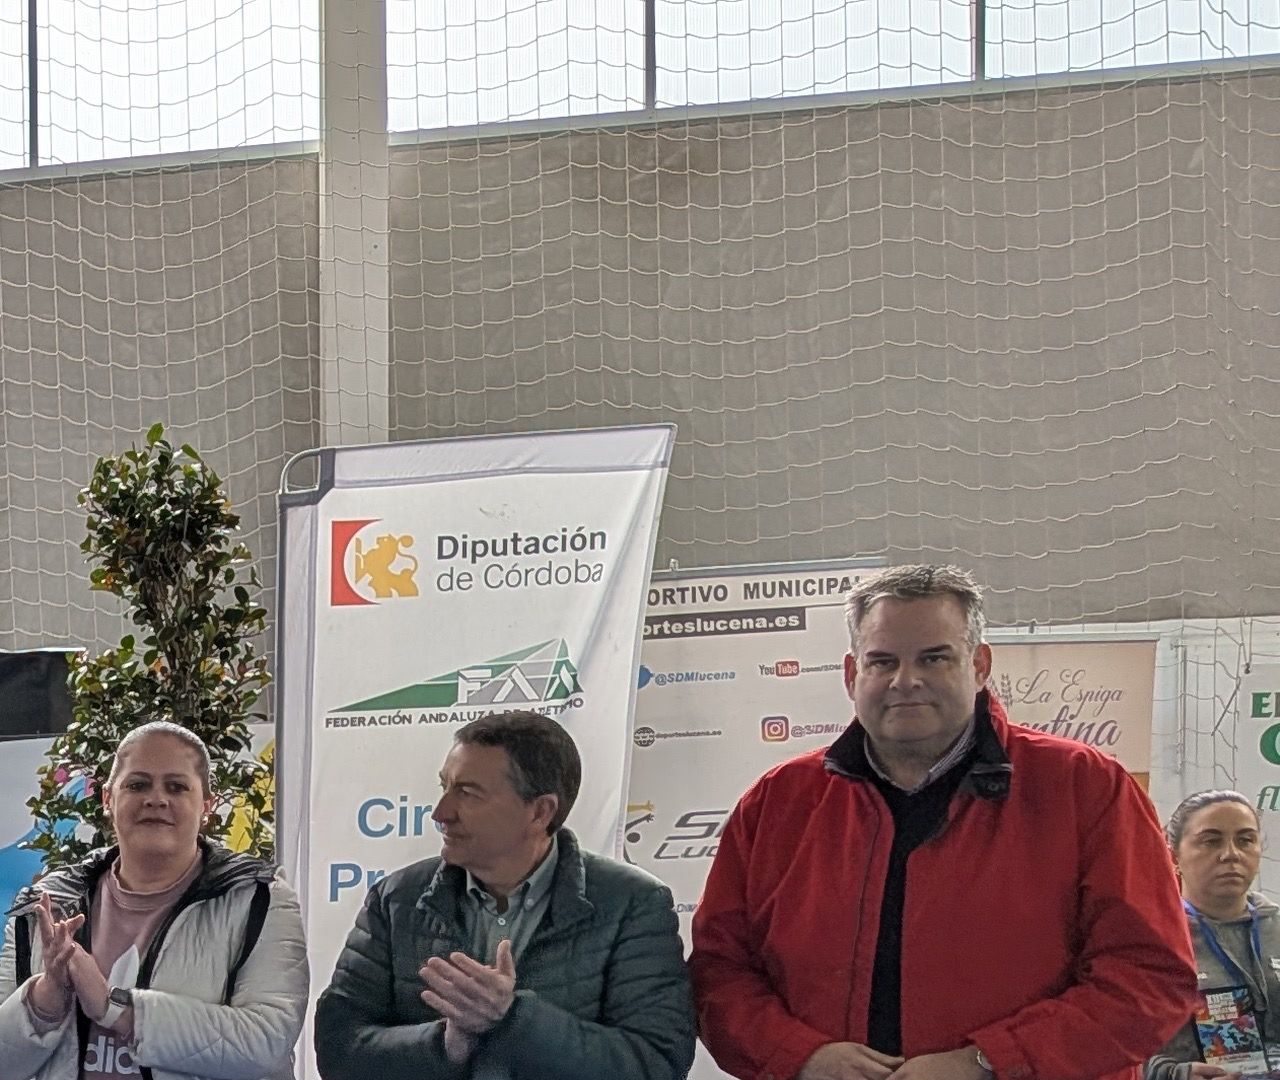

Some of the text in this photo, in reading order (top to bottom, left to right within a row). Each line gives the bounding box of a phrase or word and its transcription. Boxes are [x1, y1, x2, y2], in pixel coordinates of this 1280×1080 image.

[437, 527, 607, 563] Diputación
[436, 559, 603, 592] de Córdoba
[647, 576, 861, 606] ORTIVO MUNICIPA
[643, 614, 800, 636] orteslucena.es
[655, 671, 736, 686] @SDMlucena
[1059, 668, 1123, 718] Espiga
[325, 711, 413, 728] FEDERACIÓN
